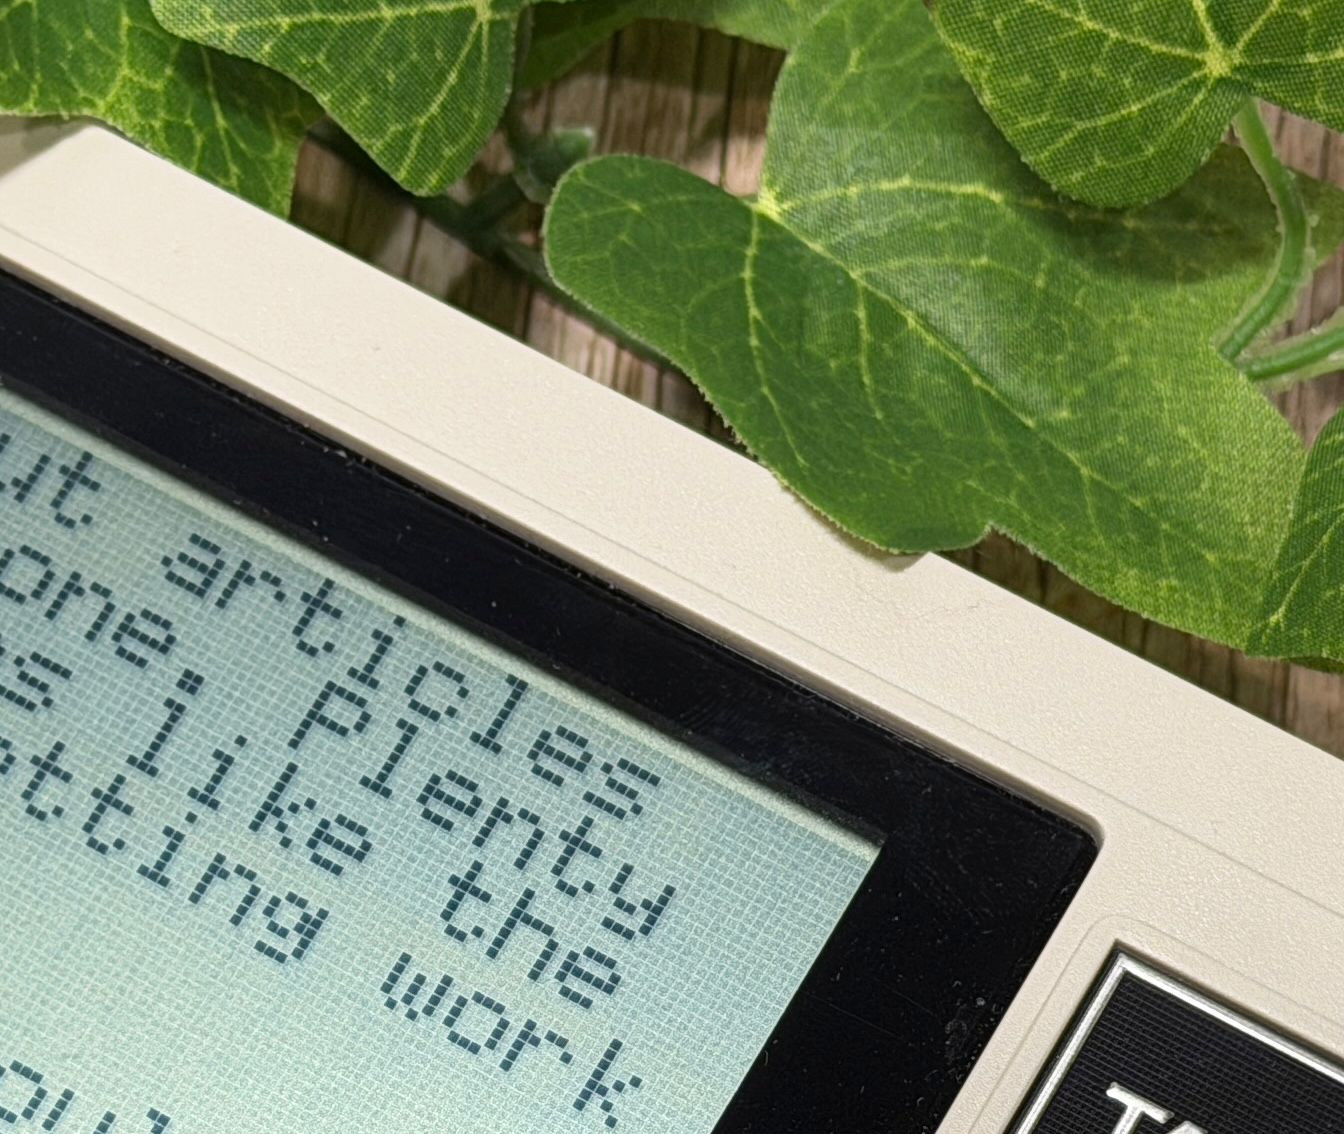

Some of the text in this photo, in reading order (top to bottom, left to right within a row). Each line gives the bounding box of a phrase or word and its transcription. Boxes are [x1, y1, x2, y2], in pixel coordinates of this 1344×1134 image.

[159, 531, 662, 822] articles
[286, 679, 677, 943] Plenty
[124, 695, 374, 879] like
[438, 858, 633, 1012] the
[378, 950, 643, 1132] work
